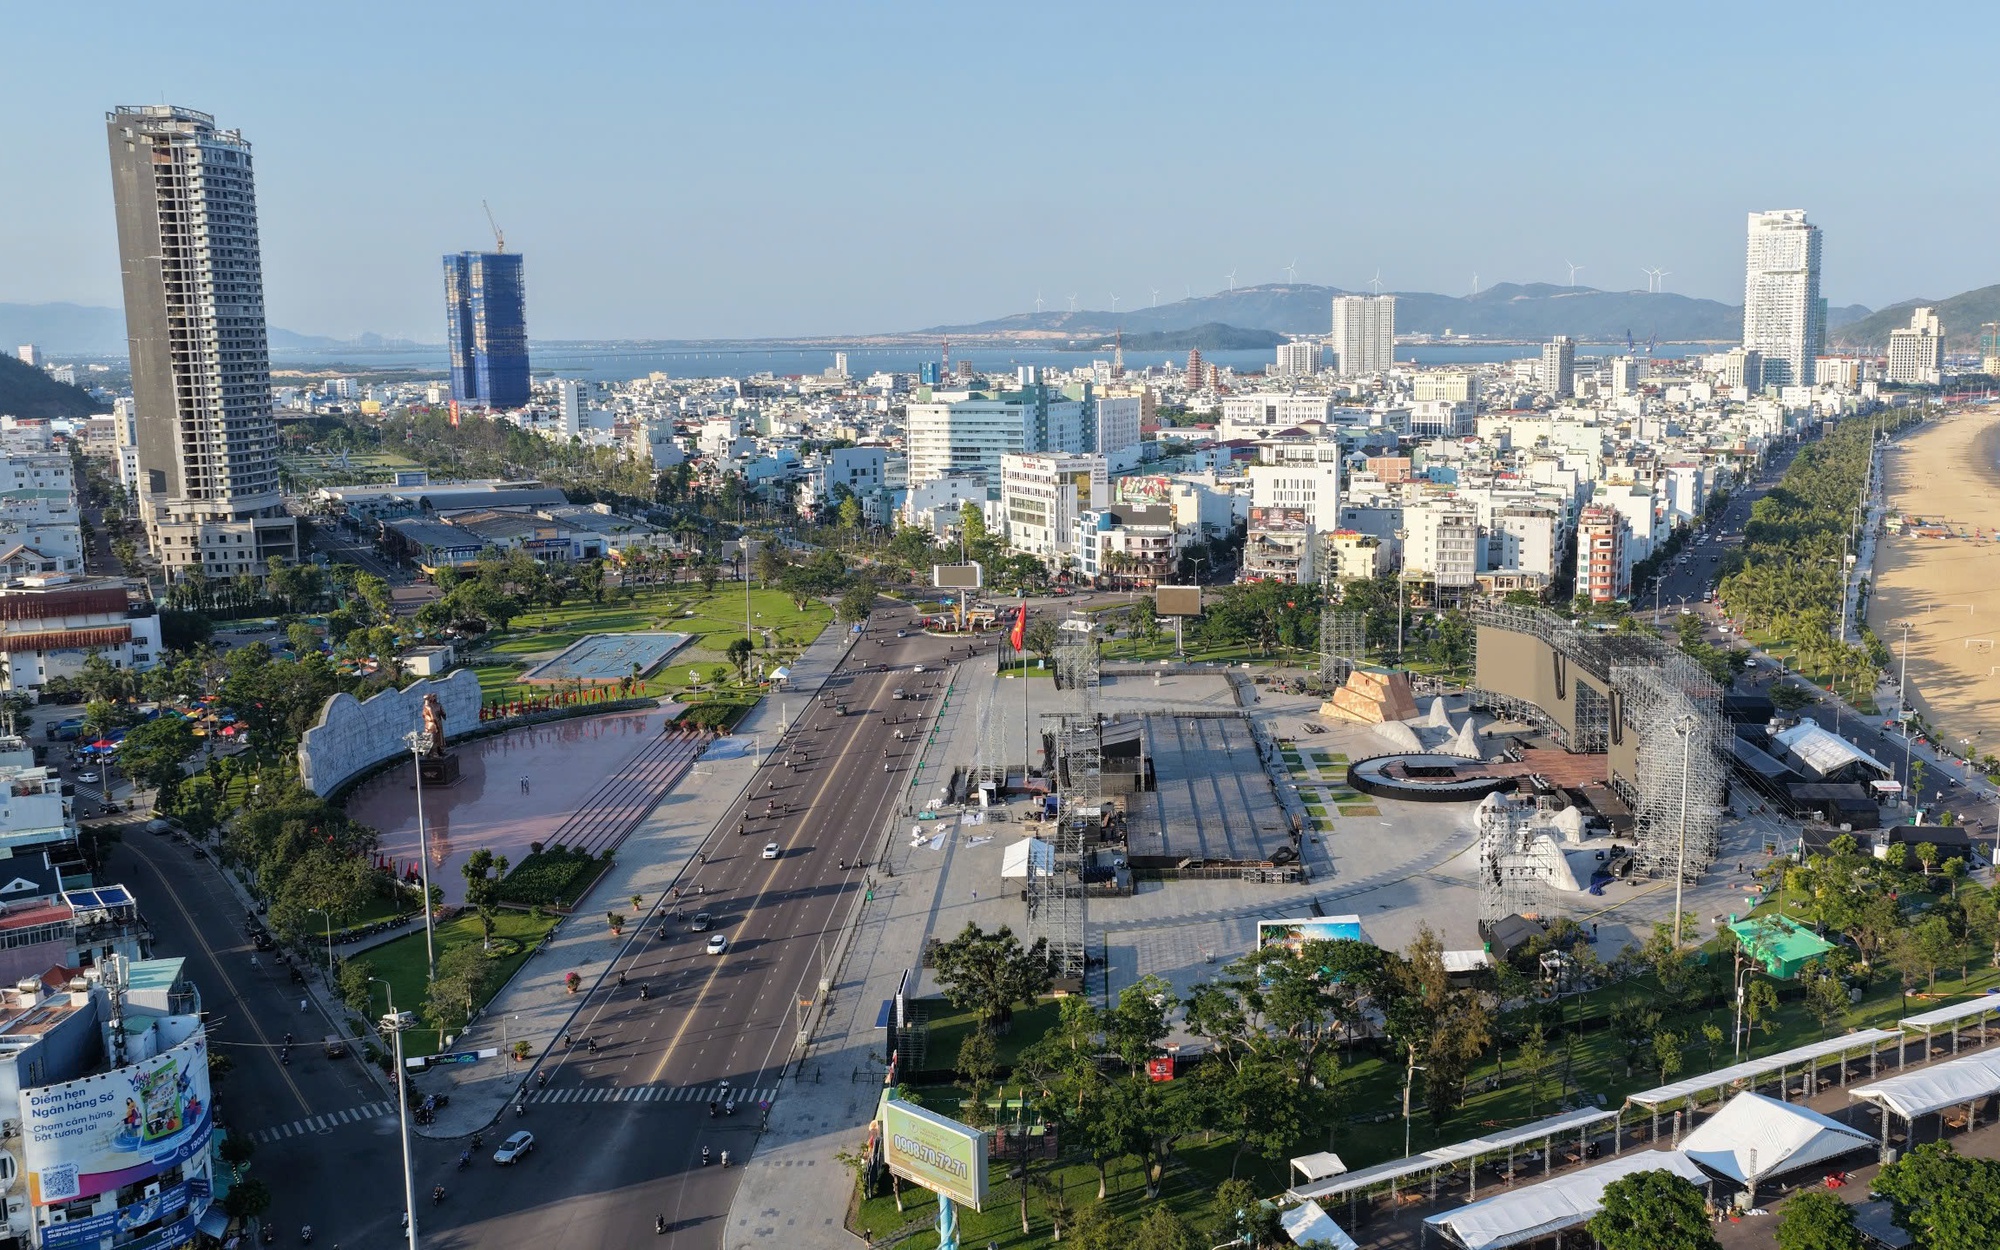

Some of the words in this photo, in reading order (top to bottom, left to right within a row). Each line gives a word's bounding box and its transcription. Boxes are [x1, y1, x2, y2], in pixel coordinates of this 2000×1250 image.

[128, 1070, 151, 1086] Vikki
[31, 1093, 62, 1106] Điểm
[64, 1089, 86, 1100] hẹn
[32, 1105, 65, 1118] Ngân
[67, 1099, 97, 1112] hàng
[99, 1090, 114, 1103] Số
[34, 1122, 63, 1133] Chạm
[65, 1117, 87, 1127] cảm
[54, 1127, 84, 1138] tương
[85, 1122, 97, 1132] lai
[190, 1134, 205, 1150] 1900
[894, 1133, 968, 1180] 0908.70.72.71
[62, 1228, 81, 1236] LƯỢNG
